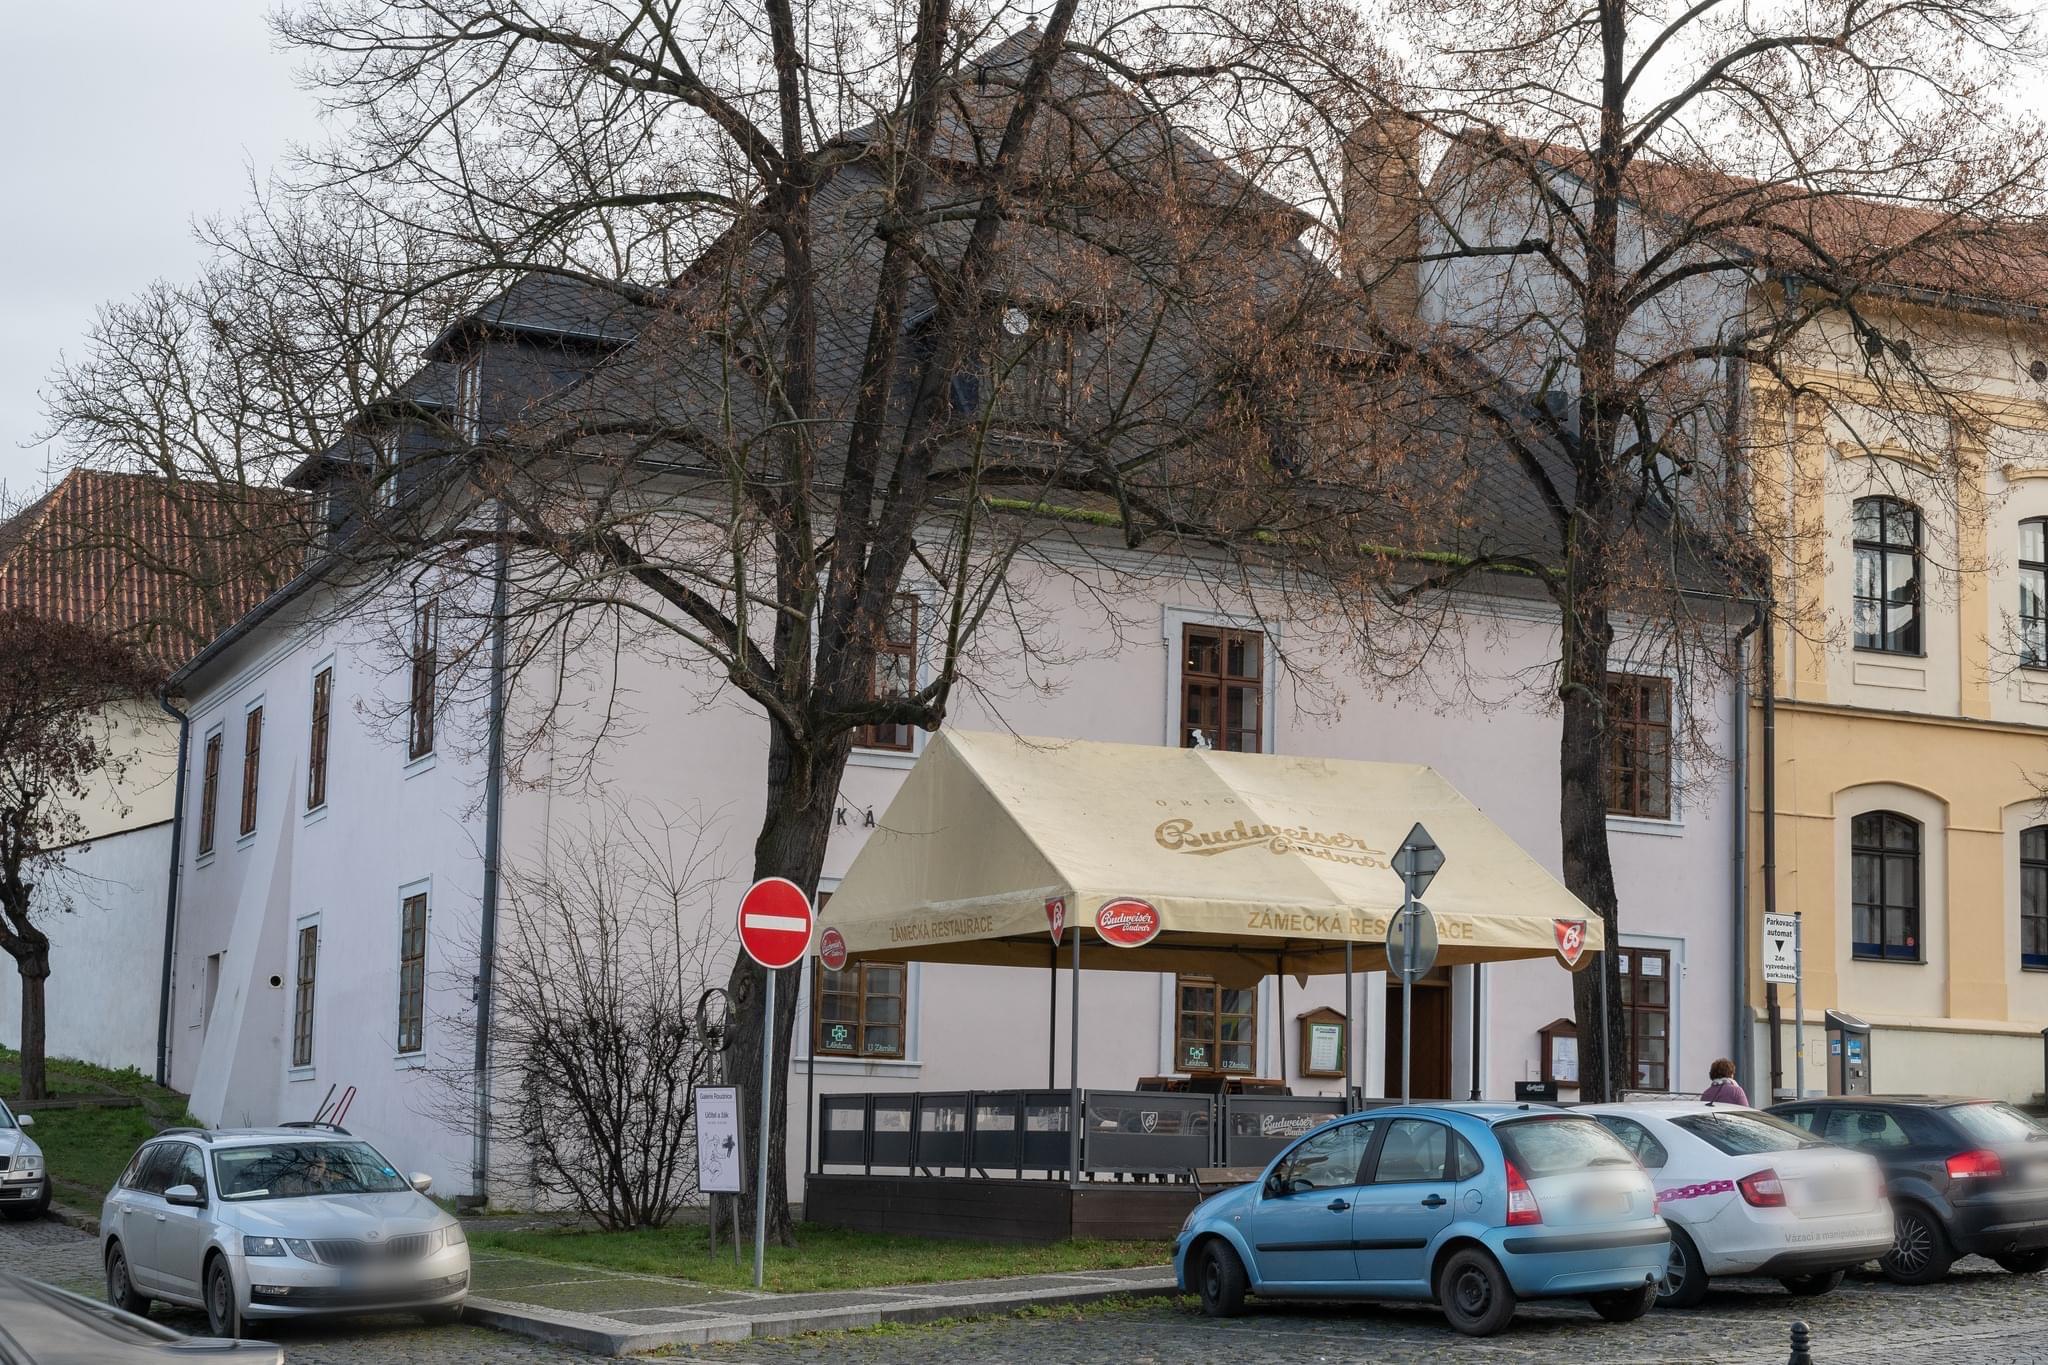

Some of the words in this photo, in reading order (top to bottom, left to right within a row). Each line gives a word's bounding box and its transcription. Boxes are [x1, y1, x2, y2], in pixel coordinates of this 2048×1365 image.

[1154, 818, 1376, 853] Budweiser
[1101, 910, 1154, 928] Budweiser
[1247, 909, 1344, 933] ZÁMECKÁ
[1350, 918, 1474, 940] RESACE
[889, 920, 930, 942] ZÁMECKÁ
[931, 915, 993, 937] RESTAURACE
[1767, 929, 1793, 938] automat
[1774, 954, 1786, 962] Zde
[1262, 1114, 1313, 1132] Budweiser
[1784, 1231, 1815, 1243] Vázací
